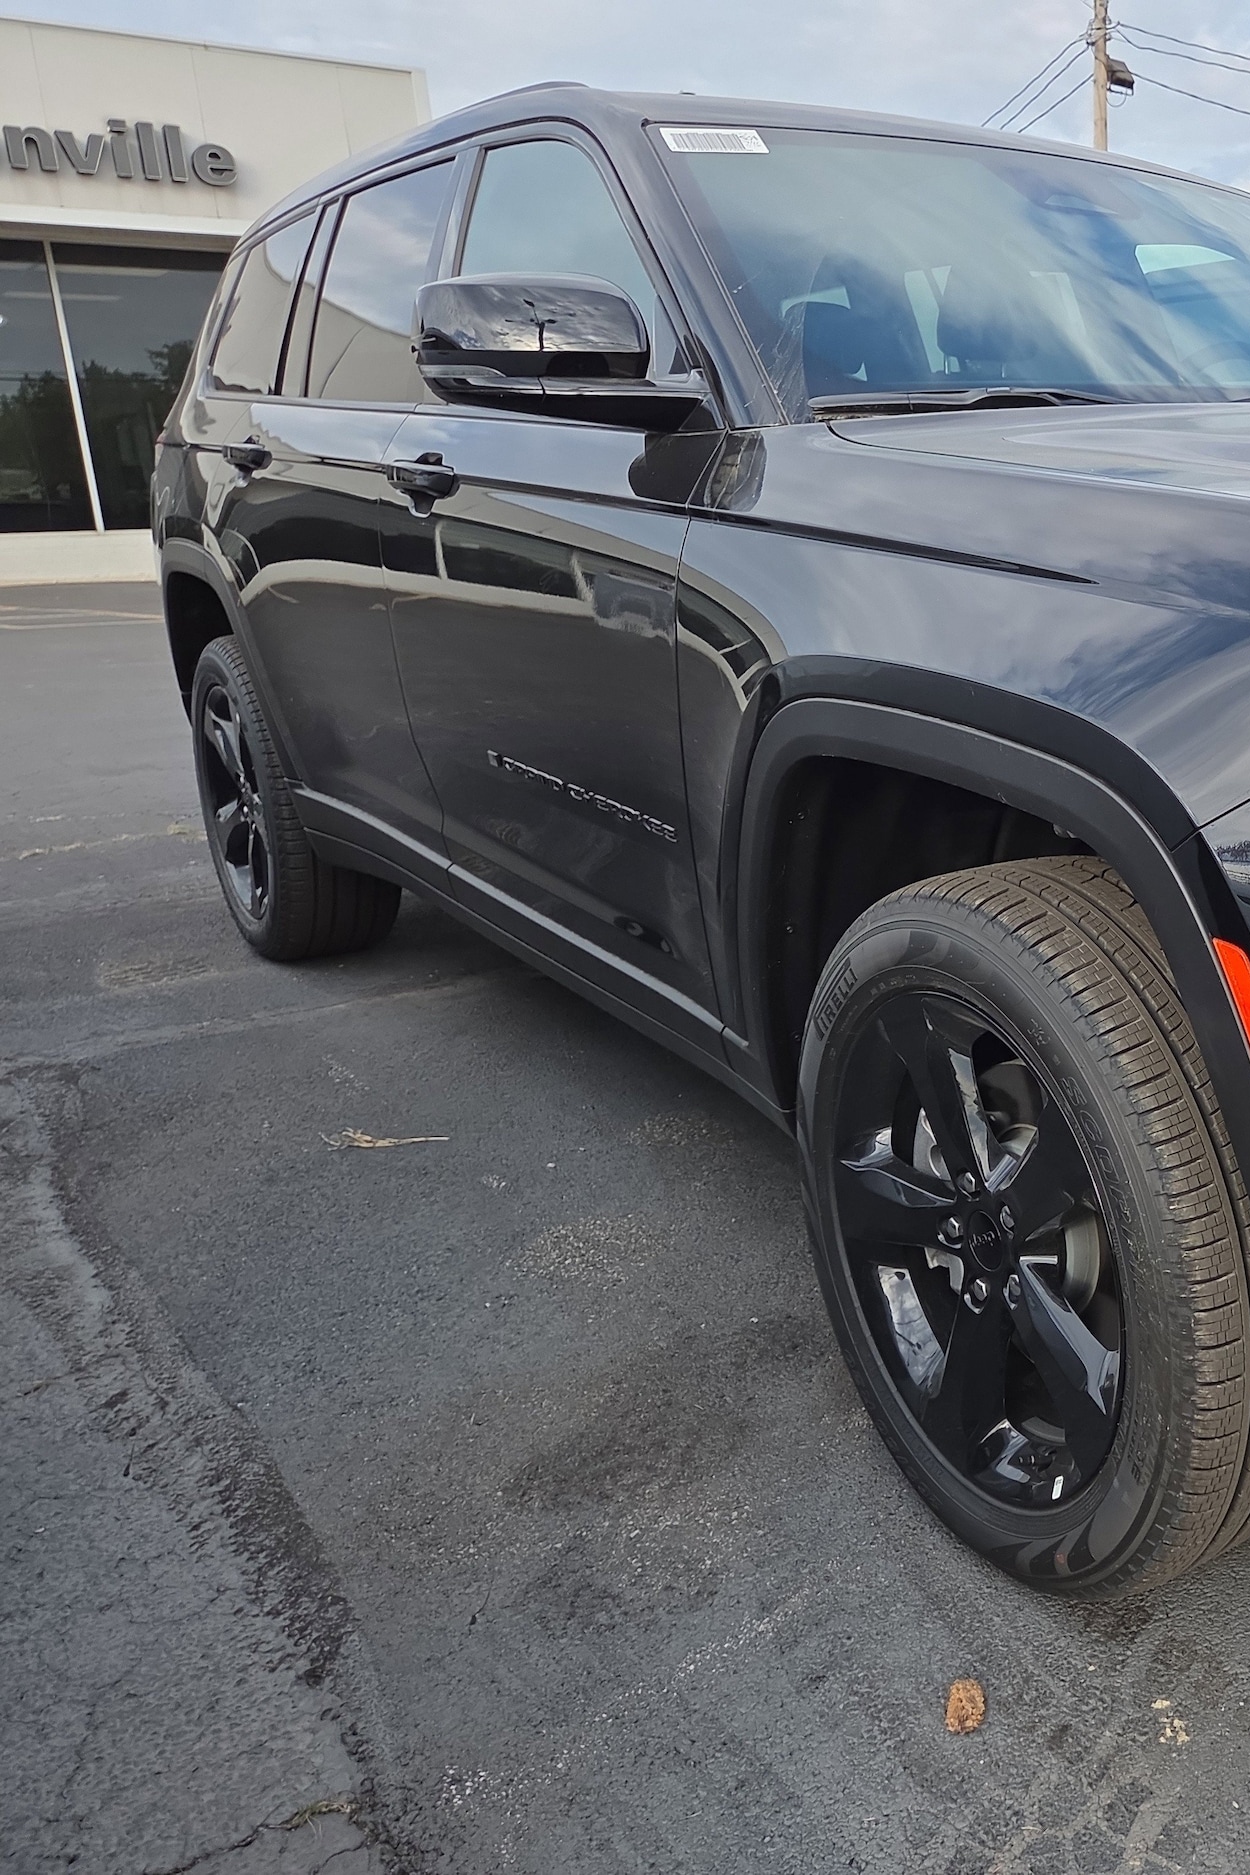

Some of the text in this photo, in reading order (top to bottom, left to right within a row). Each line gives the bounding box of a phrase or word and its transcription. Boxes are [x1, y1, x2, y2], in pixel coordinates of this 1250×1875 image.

[2, 118, 239, 187] nville
[567, 784, 677, 842] CHEROKEE
[813, 956, 858, 1041] PIRELLI
